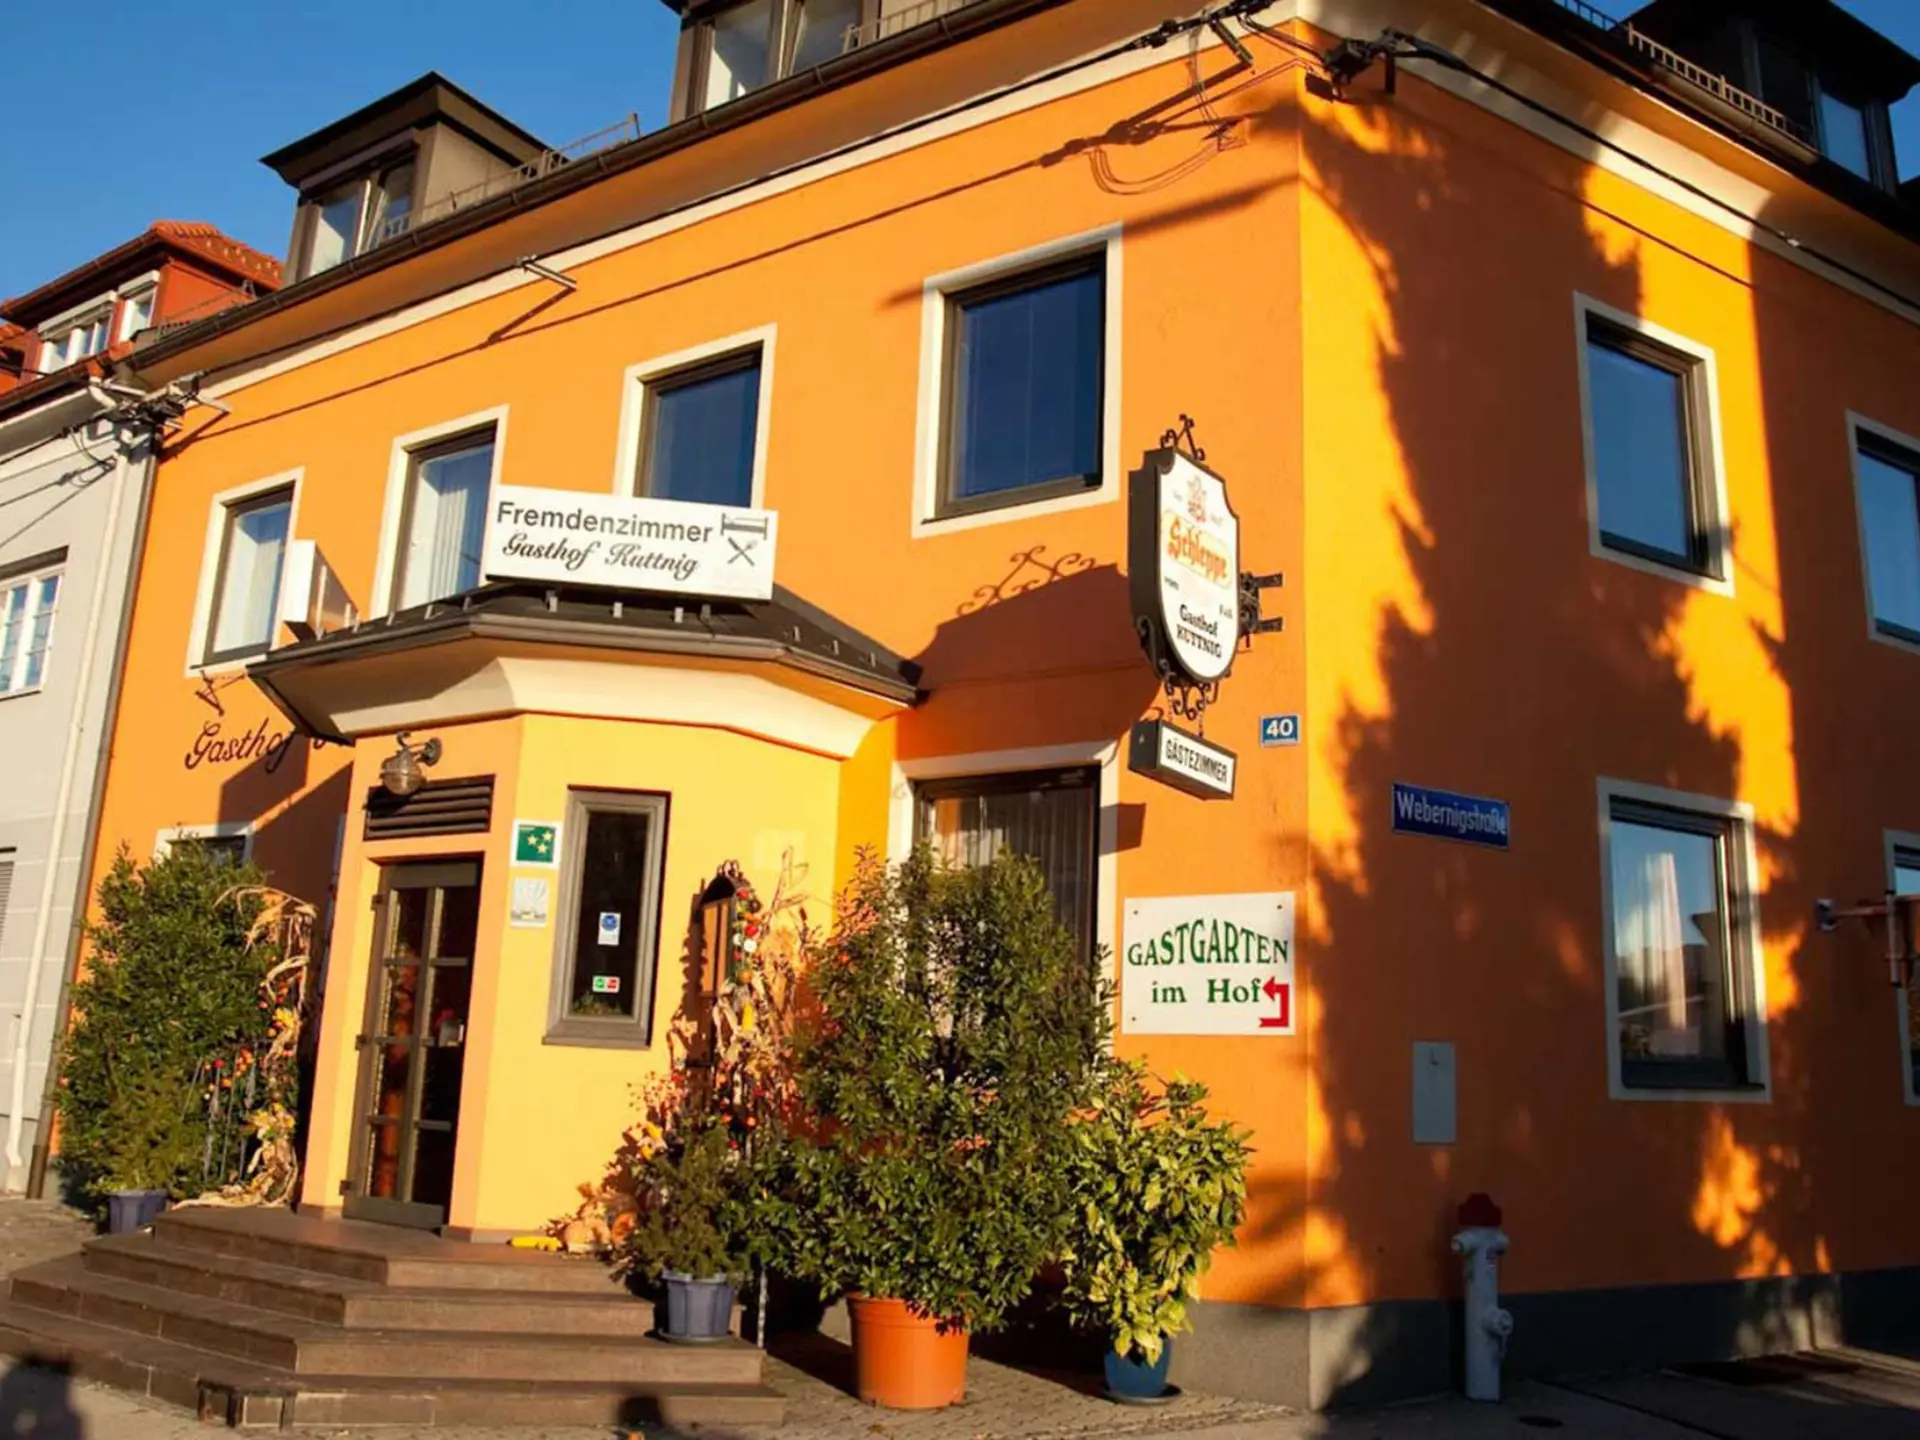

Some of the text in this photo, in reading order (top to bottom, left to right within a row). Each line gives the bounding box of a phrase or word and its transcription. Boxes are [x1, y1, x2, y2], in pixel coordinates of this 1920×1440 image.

[497, 501, 713, 543] Fremdenzimmer
[502, 532, 600, 571] Gasthof
[1179, 603, 1218, 638] Gasthof
[1266, 718, 1293, 737] 40
[1166, 737, 1227, 784] GÄSTEZIMMER
[1396, 791, 1507, 835] Webernigstraße
[1127, 918, 1289, 966] GASTGARTEN
[1151, 977, 1261, 1003] im Hof
